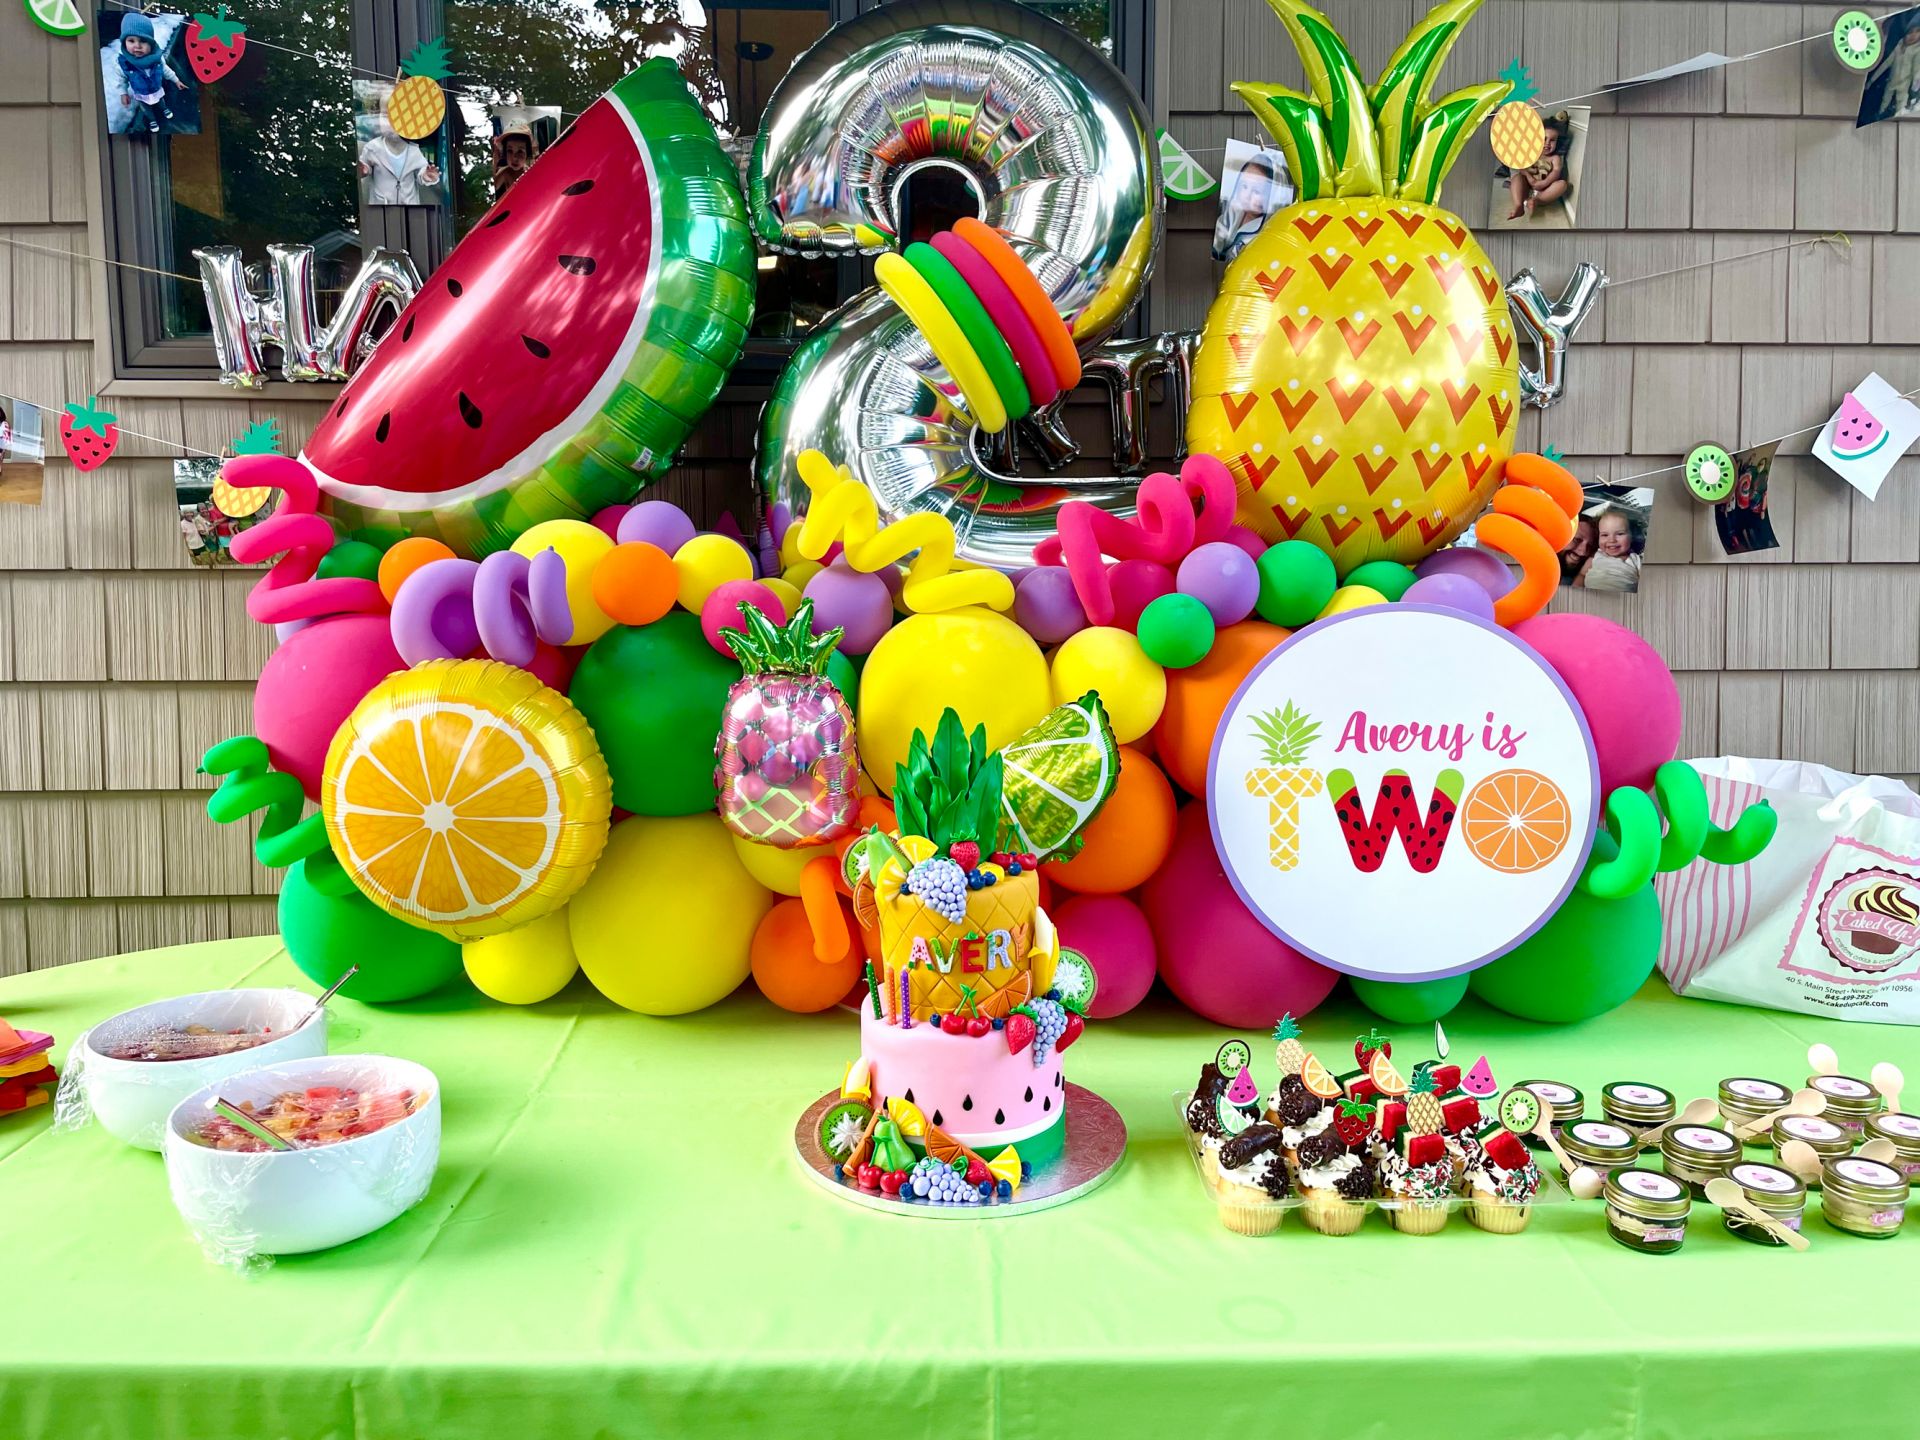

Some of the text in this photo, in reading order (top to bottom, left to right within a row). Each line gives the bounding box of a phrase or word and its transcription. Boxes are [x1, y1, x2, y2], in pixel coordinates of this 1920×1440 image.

[1334, 710, 1527, 762] Avery is
[1244, 767, 1572, 874] TWO
[1839, 911, 1883, 930] Caked
[908, 922, 1029, 974] AVERY
[1804, 981, 1824, 992] Main
[1891, 985, 1913, 993] 10956
